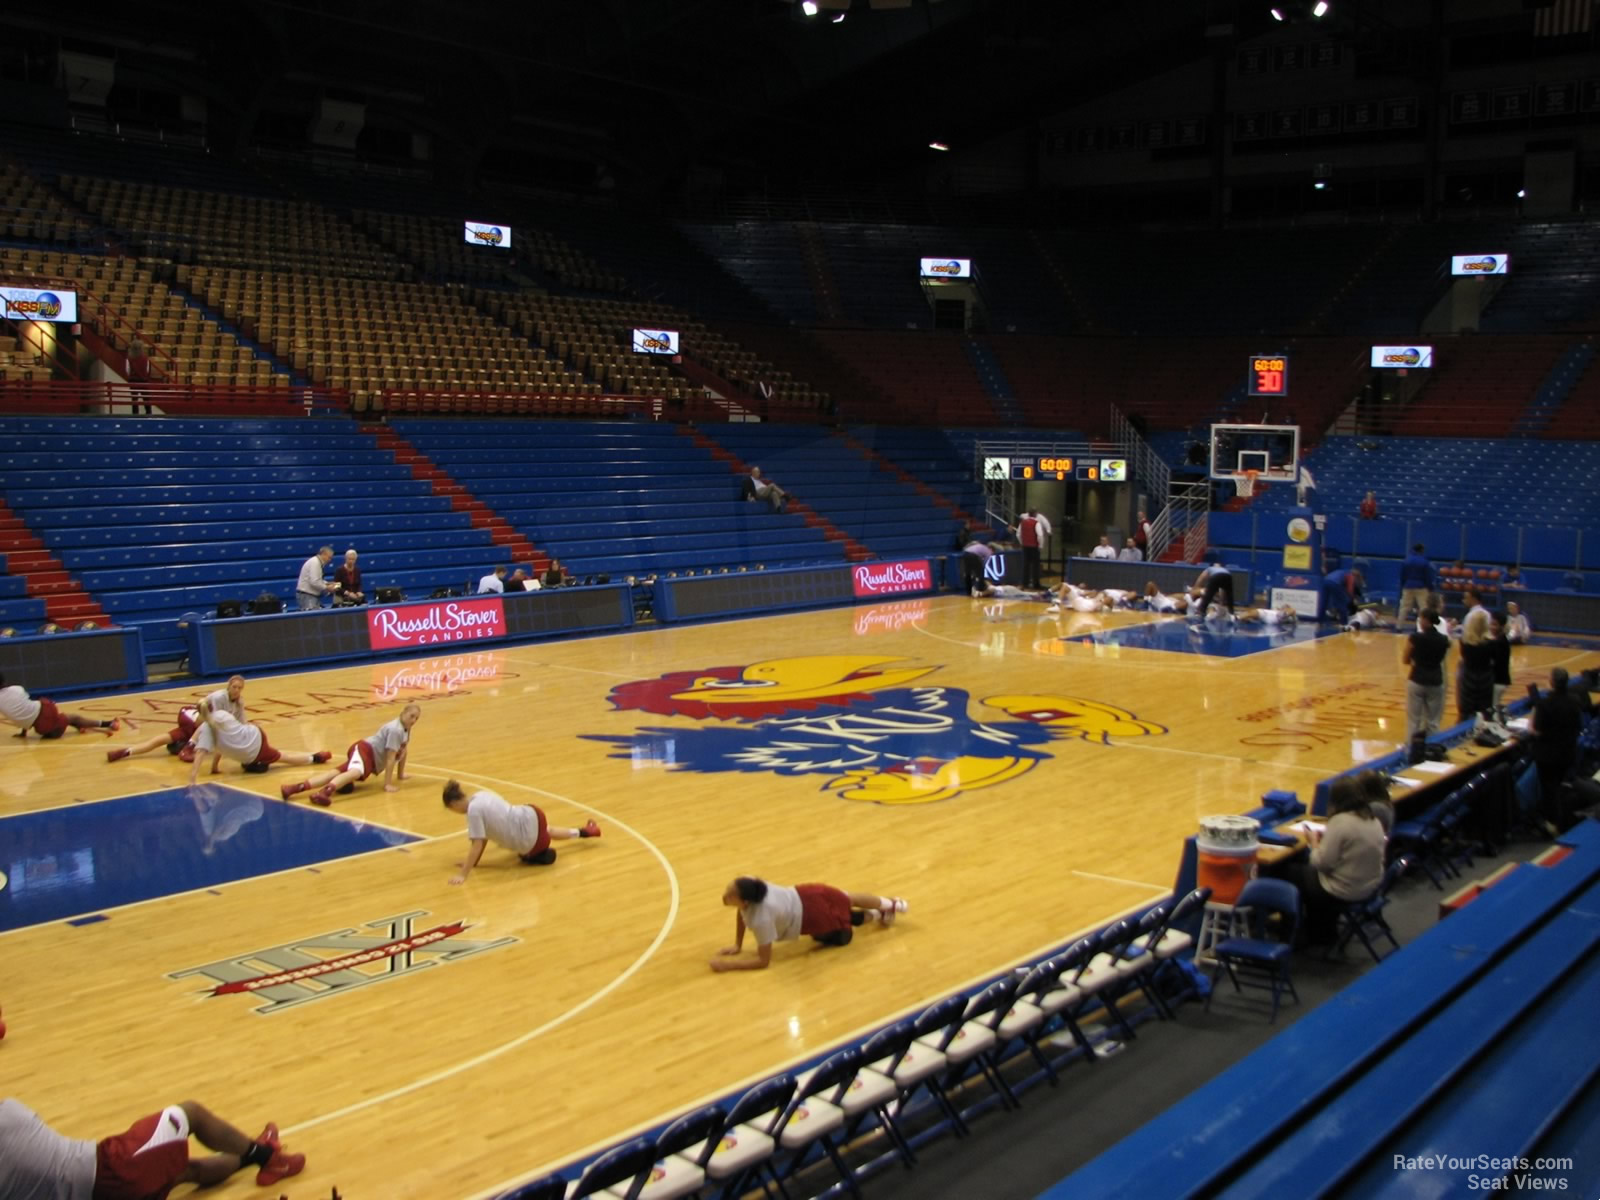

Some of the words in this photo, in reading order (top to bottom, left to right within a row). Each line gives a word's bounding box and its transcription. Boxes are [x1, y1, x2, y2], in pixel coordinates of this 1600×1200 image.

[1254, 359, 1284, 371] 60:00
[1257, 371, 1281, 392] 30
[1023, 466, 1032, 479] 0
[1040, 459, 1071, 471] 60:00
[1088, 467, 1097, 479] 0
[855, 565, 896, 591] Russell
[895, 562, 926, 584] Stover
[880, 582, 924, 594] CANDIES
[374, 606, 446, 640] Russell
[445, 602, 499, 630] Stover
[419, 627, 494, 644] CANDIES
[781, 705, 954, 744] KU
